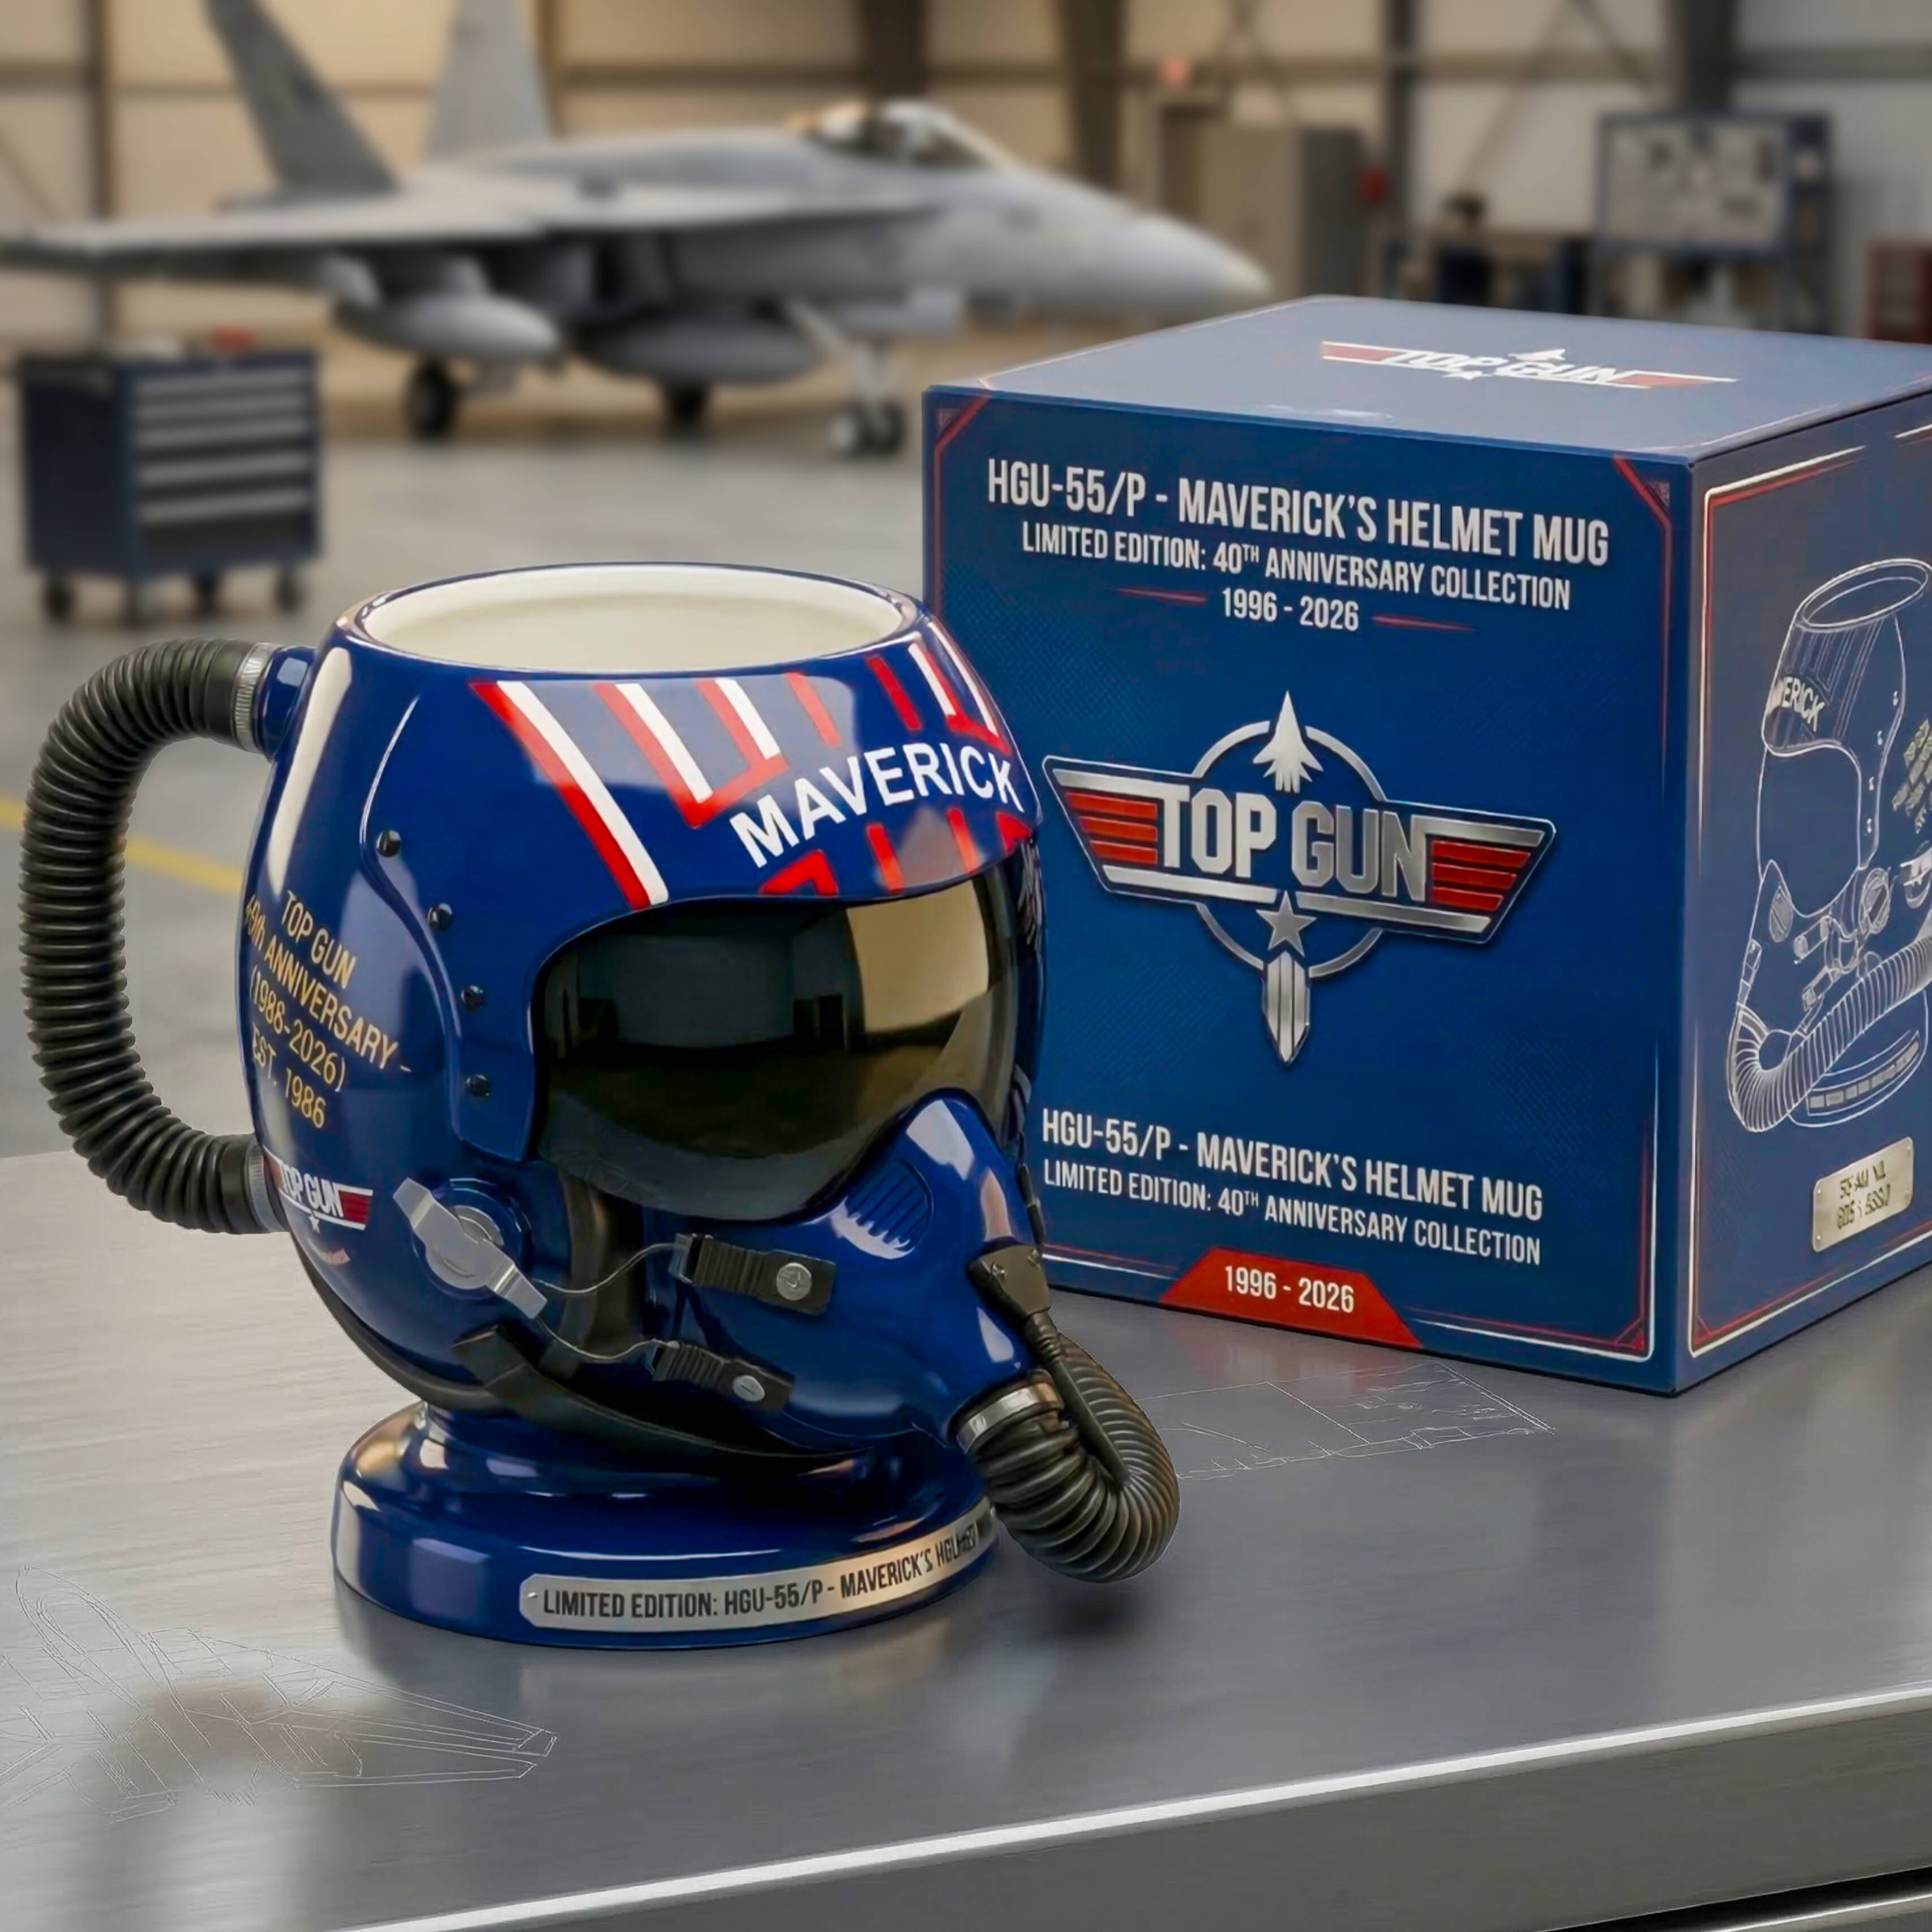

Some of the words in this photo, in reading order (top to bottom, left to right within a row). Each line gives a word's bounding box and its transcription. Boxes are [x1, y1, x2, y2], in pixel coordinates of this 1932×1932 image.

[1381, 350, 1509, 371] TOP
[1494, 361, 1630, 382] GUN
[988, 459, 1146, 517] HGU-55/P
[1156, 494, 1168, 503] -
[1179, 477, 1377, 542] MAVERICK'S
[1387, 499, 1523, 557] HELMET
[1533, 513, 1609, 566] MUG
[1023, 521, 1108, 559] LIMITED
[1115, 531, 1206, 571] EDITION:
[1265, 547, 1425, 594] ANNIVERSARY
[1430, 565, 1570, 610] COLLECTION
[1222, 587, 1278, 622] 1996
[1300, 596, 1359, 631] 2026
[1767, 676, 1825, 732] ERICK
[729, 742, 1025, 868] MAVERICK
[1155, 786, 1276, 878] TOP
[1291, 800, 1428, 902] GUN
[281, 890, 314, 944] TOP
[311, 928, 357, 990] GUN
[264, 935, 399, 1070] ANNIVERSARY
[285, 1067, 327, 1128] 1986
[303, 1173, 344, 1218] GUN
[1042, 1108, 1171, 1160] HGU-55/P
[1197, 1132, 1357, 1192] MAVERICK'S
[1365, 1159, 1474, 1210] HELMET
[1481, 1176, 1543, 1221] MUG
[1044, 1159, 1123, 1196] LIMITED
[1128, 1172, 1211, 1211] EDITION:
[1264, 1194, 1408, 1243] ANNIVERSARY
[1415, 1219, 1540, 1266] COLLECTION
[1225, 1265, 1276, 1300] 1996
[1299, 1277, 1355, 1313] 2026
[543, 1588, 624, 1617] LIMITED
[631, 1591, 718, 1618] EDITION:
[725, 1579, 823, 1616] HGU-55/P
[840, 1548, 933, 1599] MAVERICK'S
